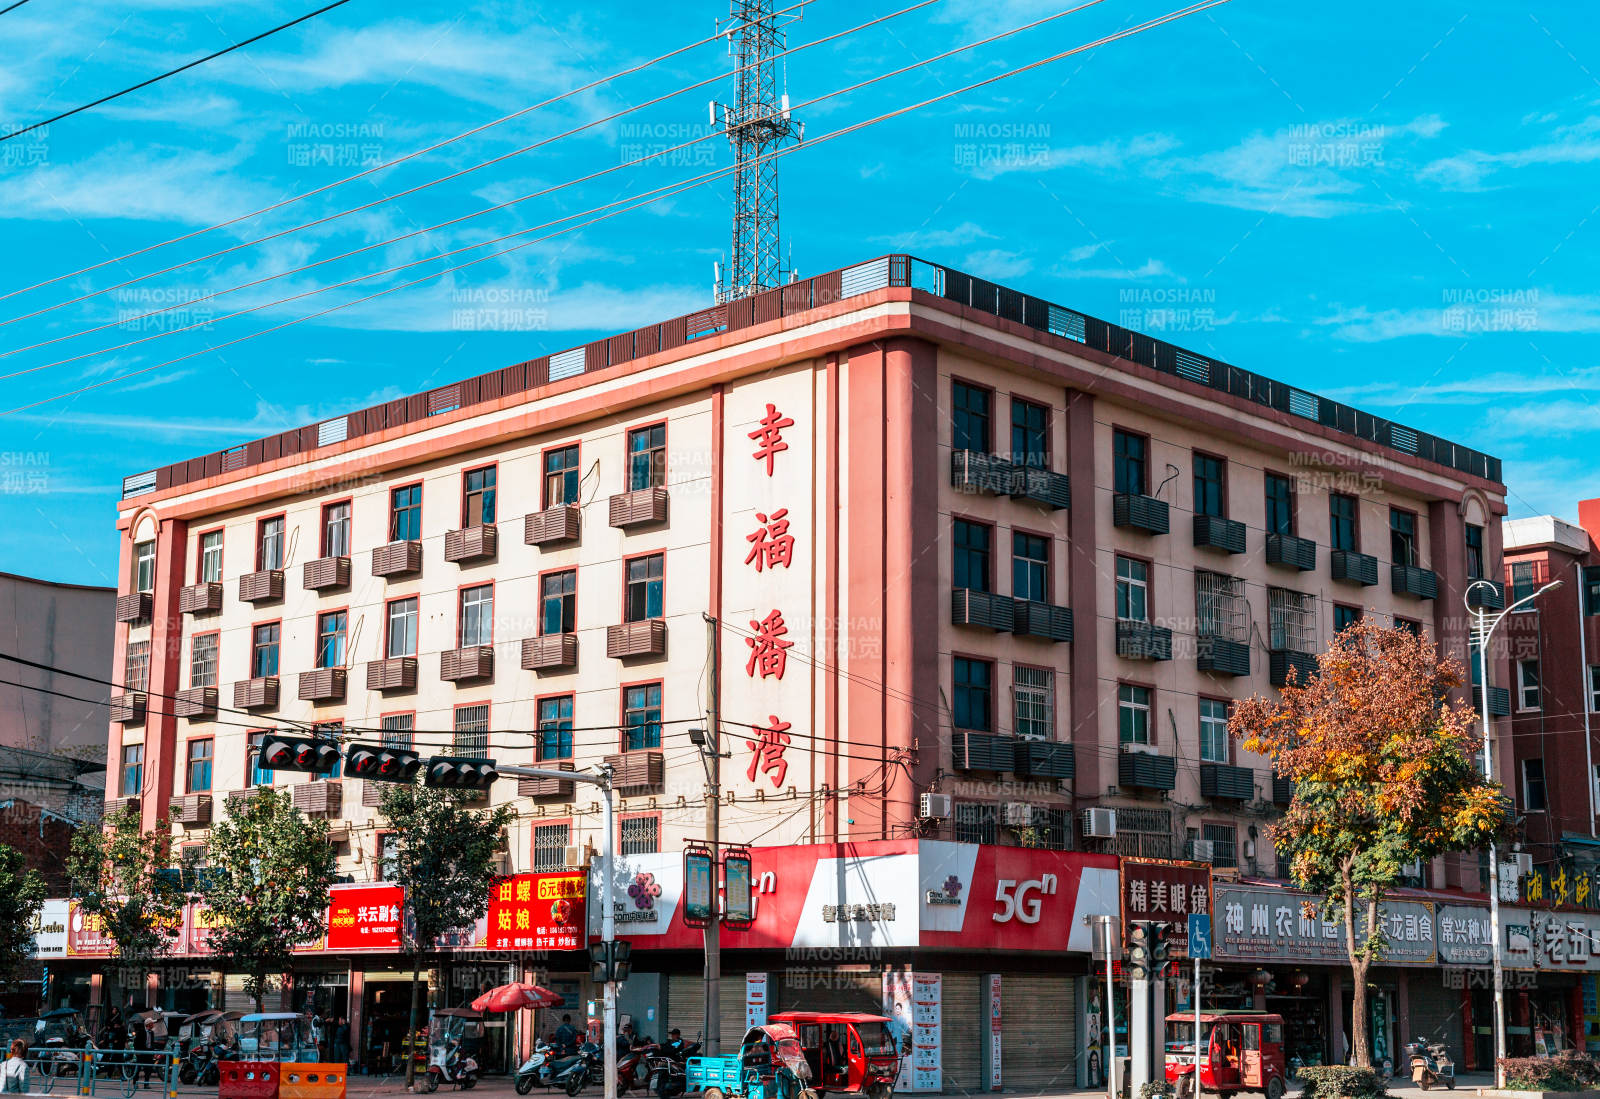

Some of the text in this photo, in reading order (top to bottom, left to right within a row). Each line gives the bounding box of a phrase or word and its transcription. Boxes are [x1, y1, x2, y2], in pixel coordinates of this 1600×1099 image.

[744, 403, 795, 788] 幸福潘湾
[500, 880, 531, 902] 田螺
[1130, 880, 1207, 914] 精美眼镜
[357, 905, 399, 922] 兴云副食
[498, 908, 530, 930] 姑娘
